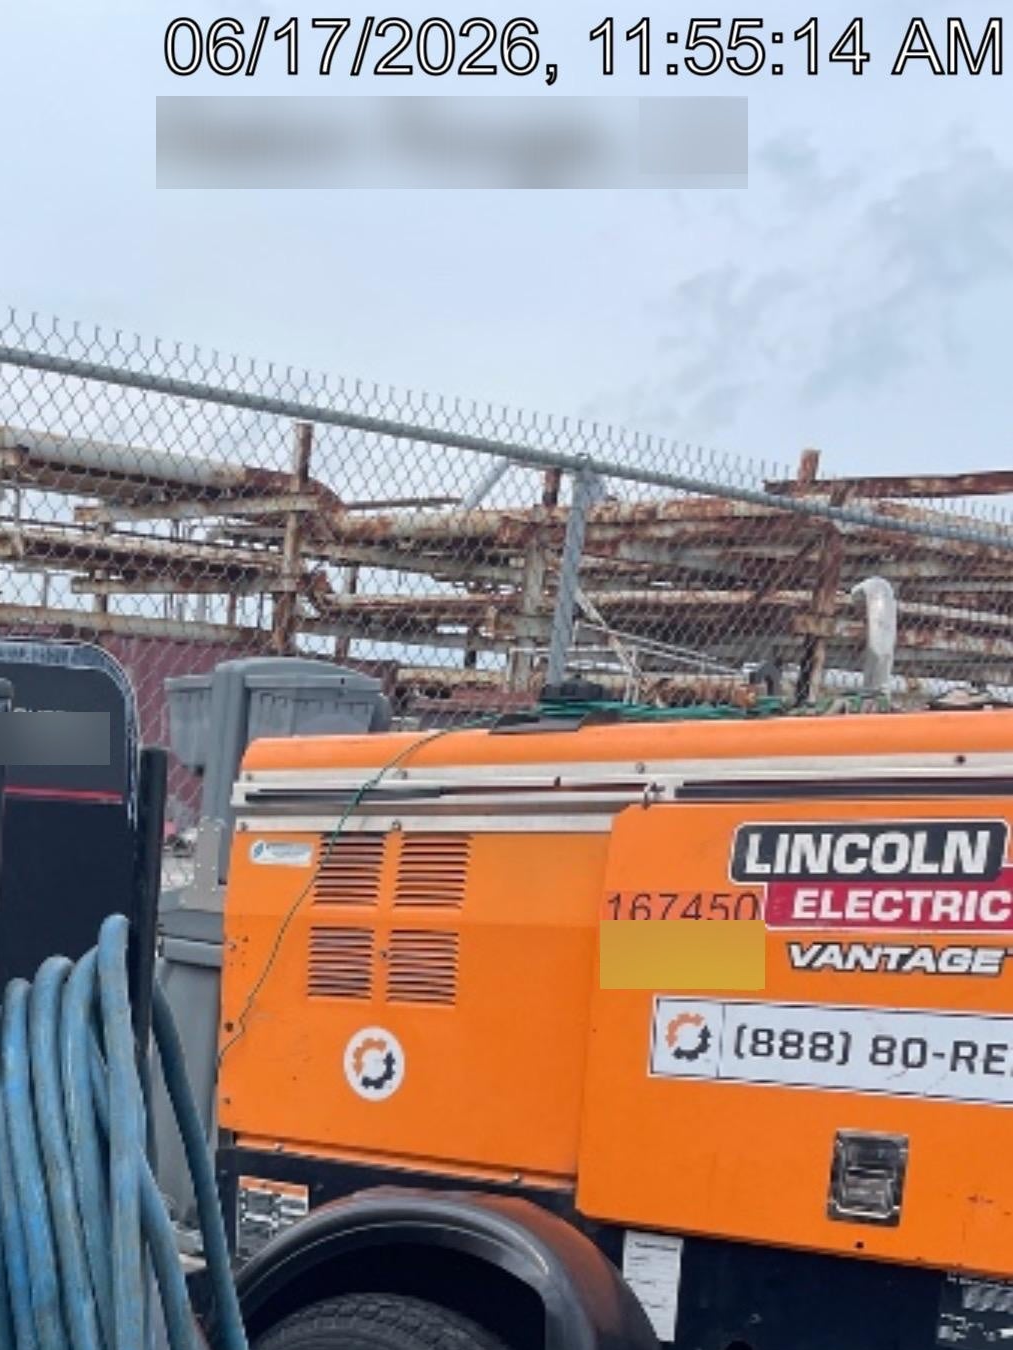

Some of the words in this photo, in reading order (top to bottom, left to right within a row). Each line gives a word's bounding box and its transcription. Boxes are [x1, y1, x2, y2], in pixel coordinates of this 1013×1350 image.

[744, 831, 990, 875] LINCOLN
[791, 888, 1012, 922] ELECTRIC
[788, 942, 1006, 976] VANTAGE
[733, 1023, 853, 1066] (888)
[868, 1034, 1013, 1076] 80-RE
